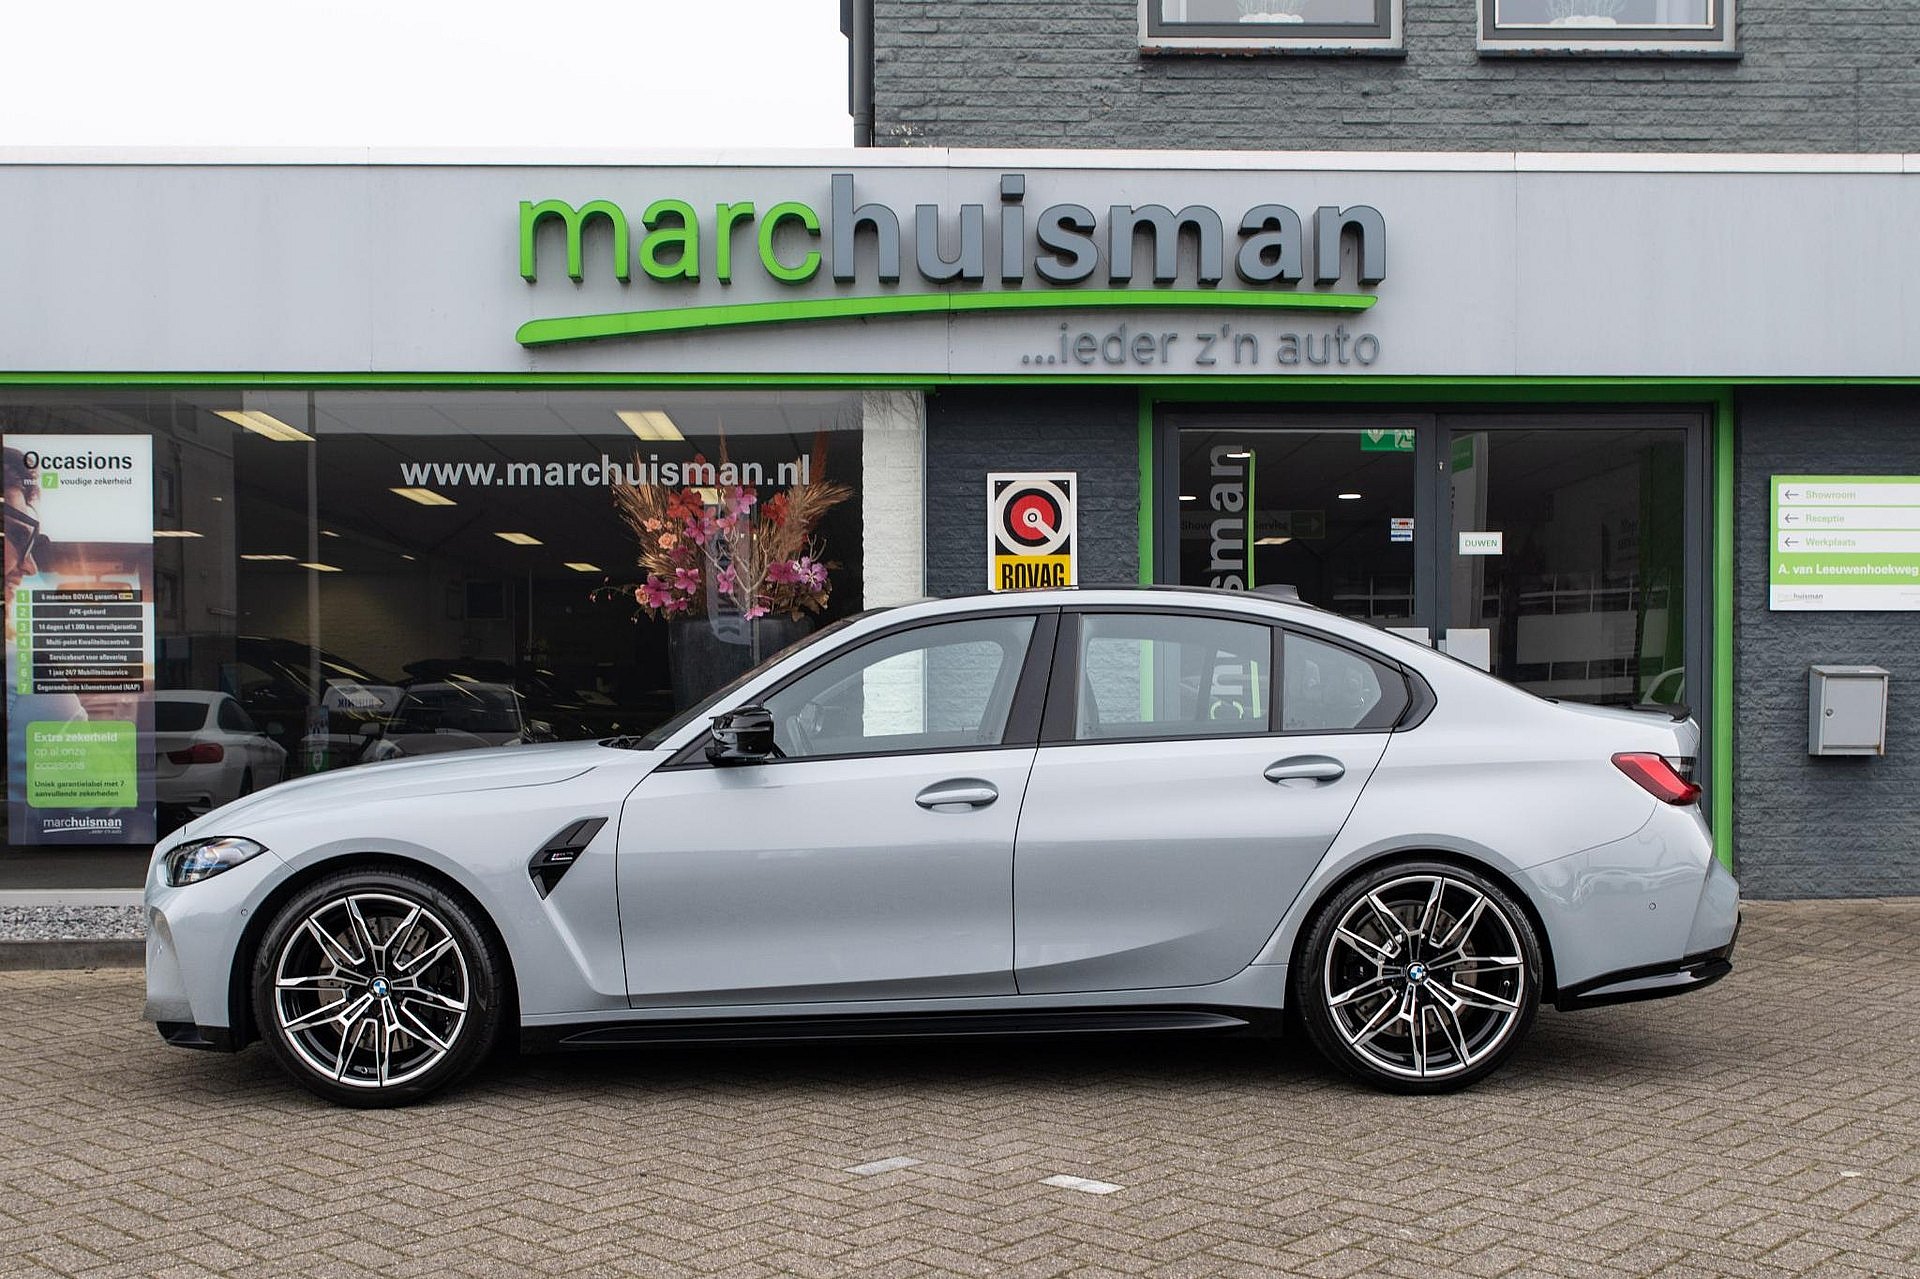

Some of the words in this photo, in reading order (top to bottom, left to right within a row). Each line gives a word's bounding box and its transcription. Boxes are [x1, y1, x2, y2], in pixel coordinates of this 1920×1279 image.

[519, 173, 1386, 287] marchuisman
[1022, 323, 1178, 365] ...ieder
[1196, 324, 1259, 365] z'n
[1277, 324, 1381, 365] auto
[23, 451, 133, 470] Occasions
[401, 453, 810, 487] www.marchuisman.nl
[60, 476, 92, 486] voudige
[94, 476, 132, 485] zekerheid
[1806, 490, 1856, 499] Showroom
[1806, 513, 1845, 523] Receptie
[1806, 537, 1856, 547] Werkplaats
[1001, 562, 1065, 590] BOVAG
[1778, 563, 1790, 574] A.
[1793, 565, 1813, 574] van
[1815, 563, 1919, 577] Leeuwenhoekweg
[34, 732, 63, 742] Extra
[66, 731, 118, 742] zekerheid
[43, 816, 122, 827] marchuisman
